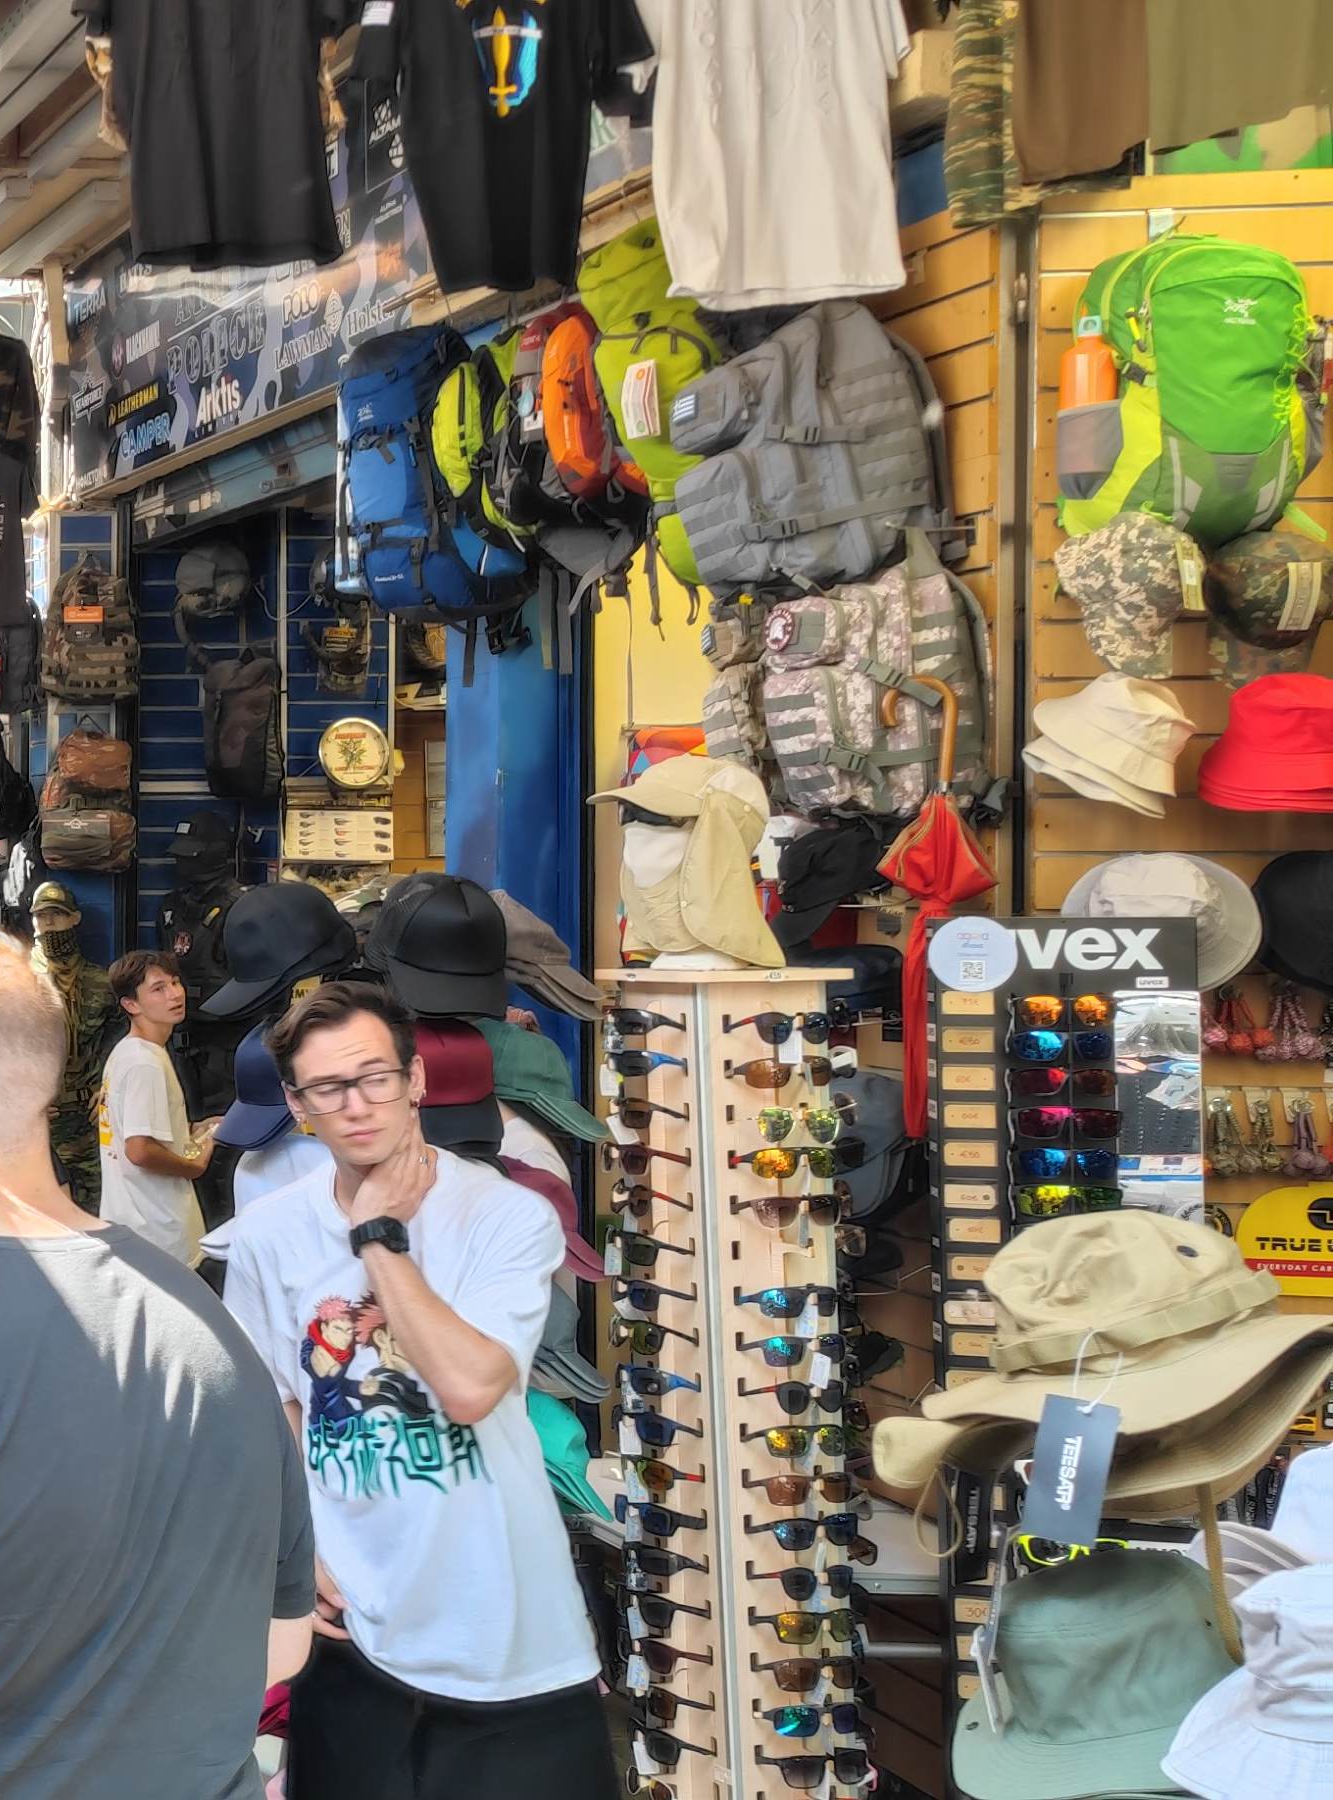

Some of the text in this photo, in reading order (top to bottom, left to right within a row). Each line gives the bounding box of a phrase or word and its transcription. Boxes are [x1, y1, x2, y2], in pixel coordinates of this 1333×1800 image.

[369, 114, 402, 147] ALTAM
[73, 286, 107, 325] TERRA
[282, 280, 322, 328] POLO
[167, 299, 267, 396] POLICE
[274, 324, 333, 373] LAWMAN
[118, 382, 159, 419] LEATHERMAN
[195, 374, 241, 428] Arktis
[121, 412, 172, 461] CAMPER
[1255, 1236, 1322, 1252] TRUE
[1256, 1263, 1308, 1272] EVERYDAY
